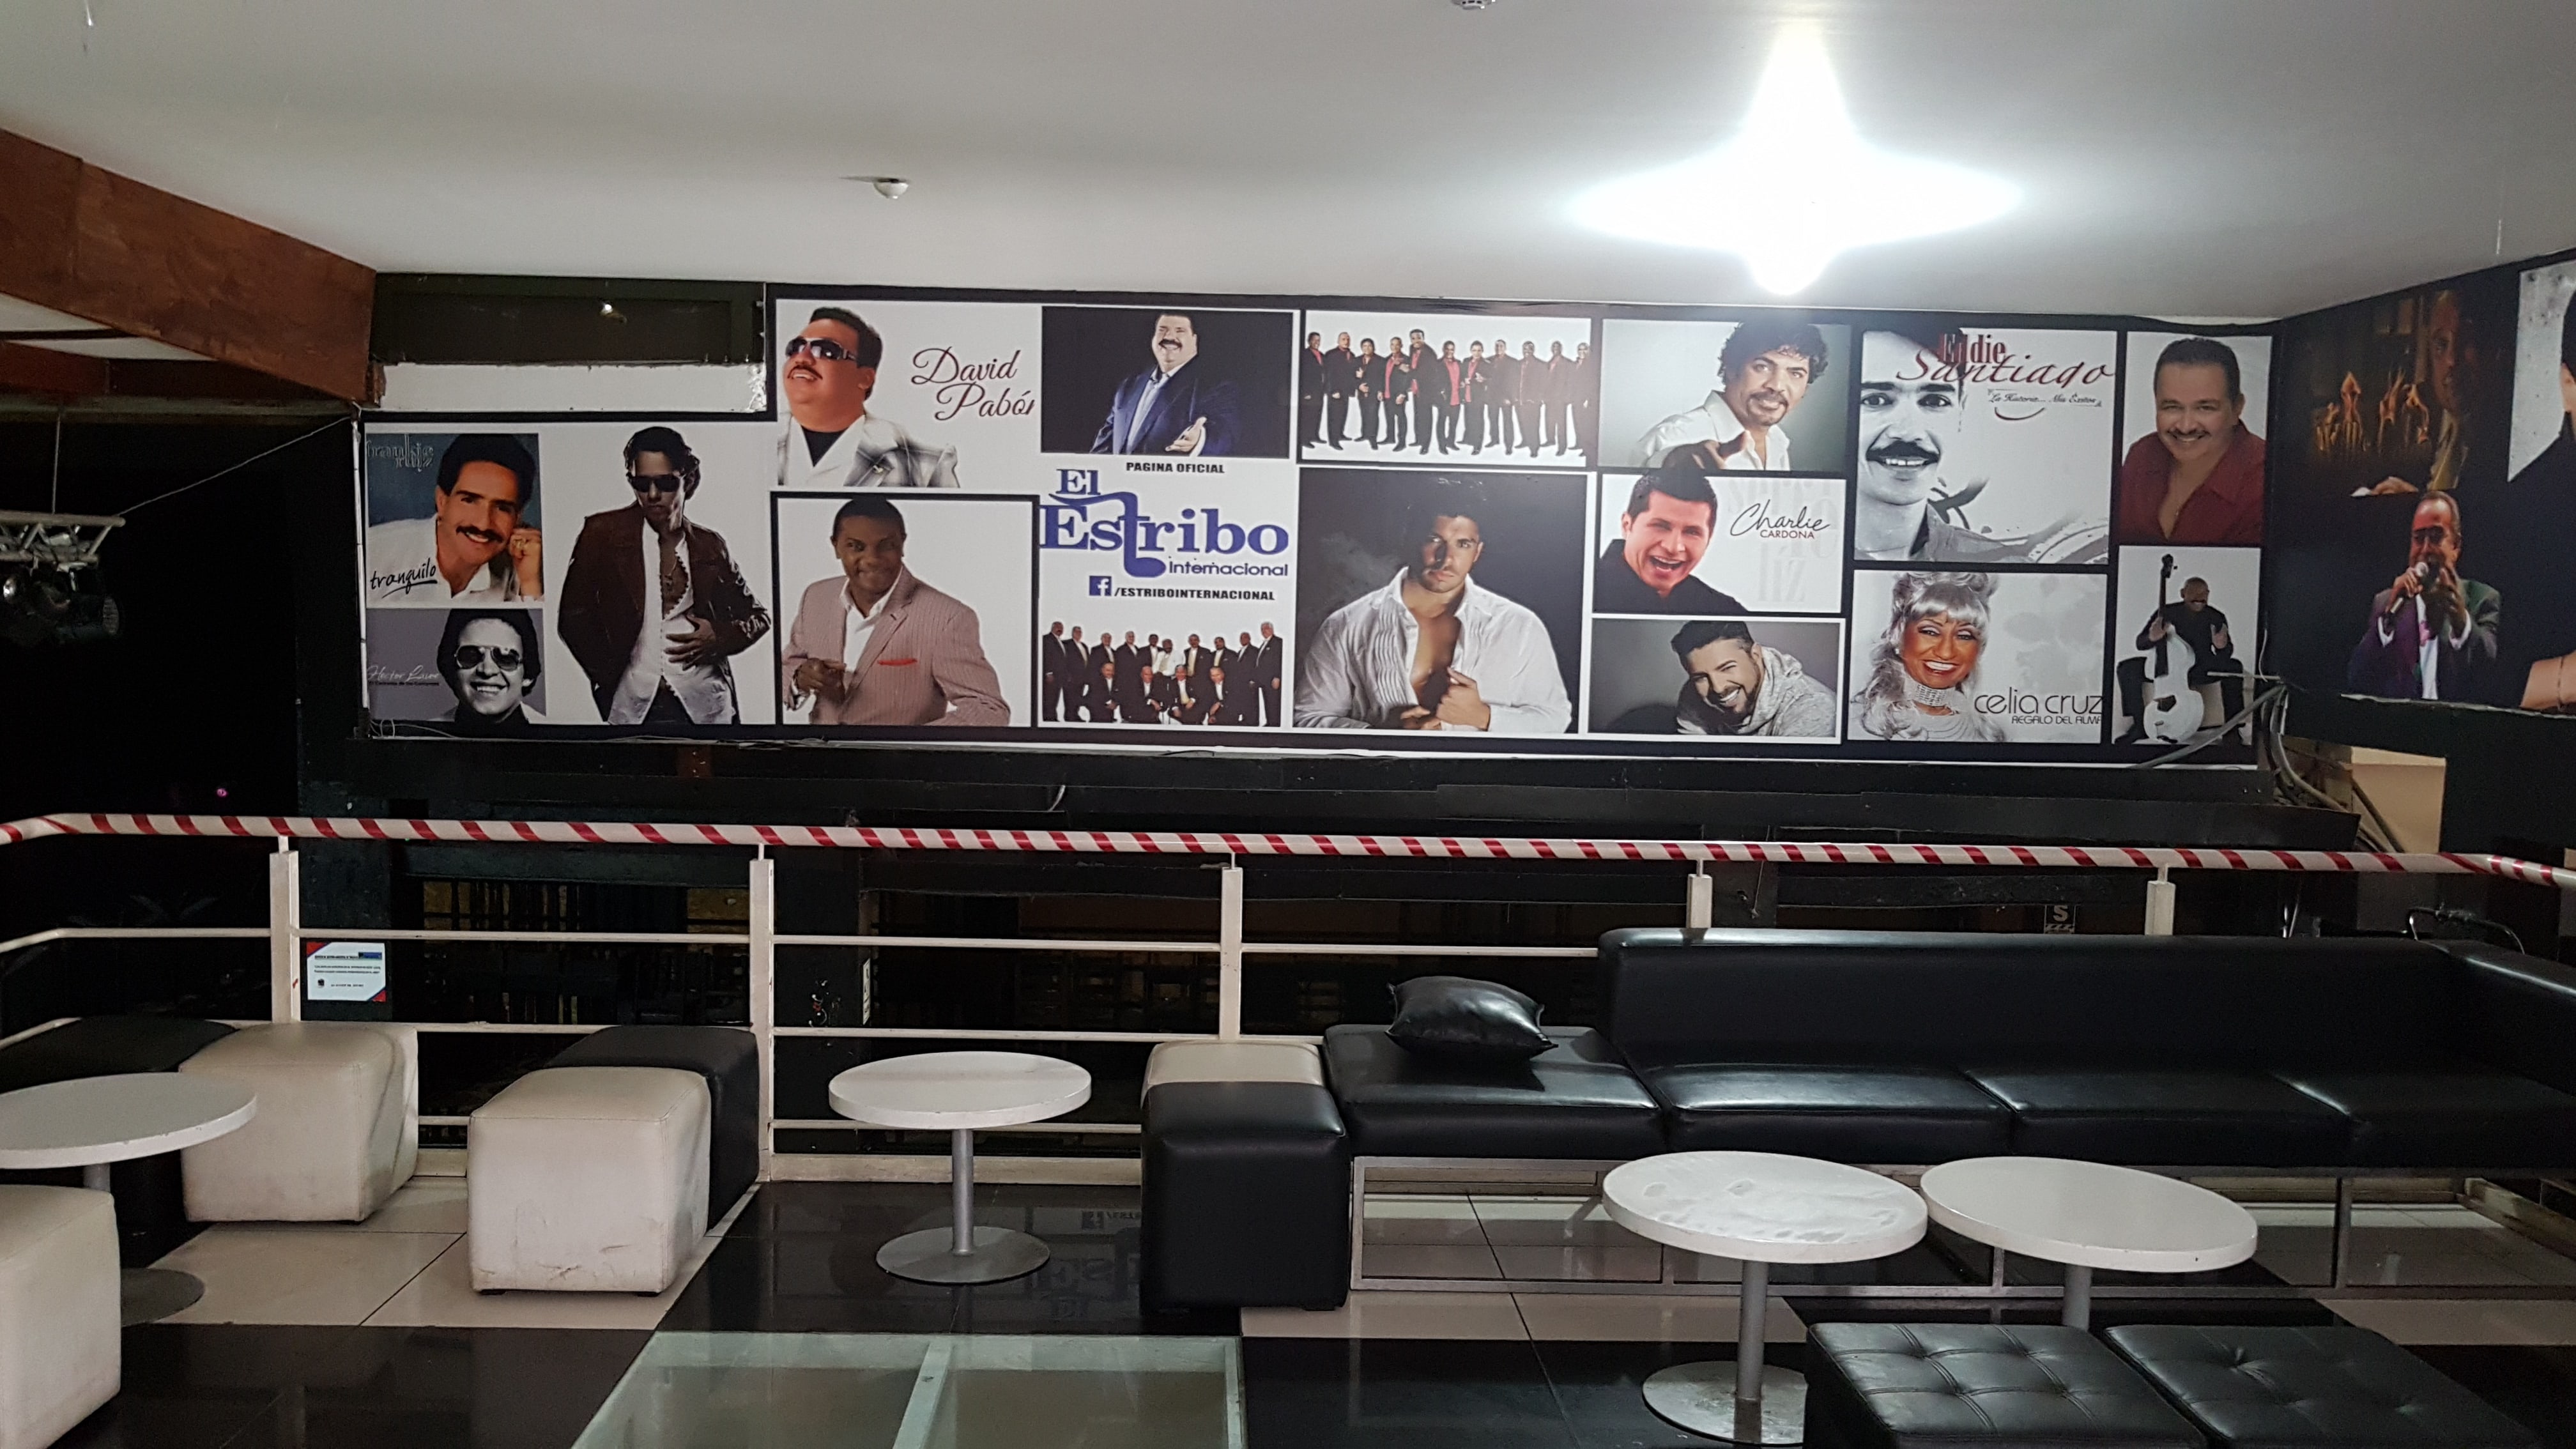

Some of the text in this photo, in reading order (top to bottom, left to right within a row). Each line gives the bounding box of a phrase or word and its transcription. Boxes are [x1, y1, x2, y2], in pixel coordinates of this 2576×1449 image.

[911, 346, 1021, 385] David
[1896, 349, 2115, 388] Santiago
[1055, 468, 1101, 495] El
[1126, 462, 1225, 473] PAGINA OFICIAL
[1730, 499, 1830, 536] Charlie
[1039, 492, 1289, 578] Estribo
[1759, 530, 1815, 539] CARDONA
[371, 557, 438, 597] tranquilo
[1974, 687, 2103, 714] celia cruz
[2012, 716, 2053, 724] REGALO
[2055, 716, 2073, 724] DEL
